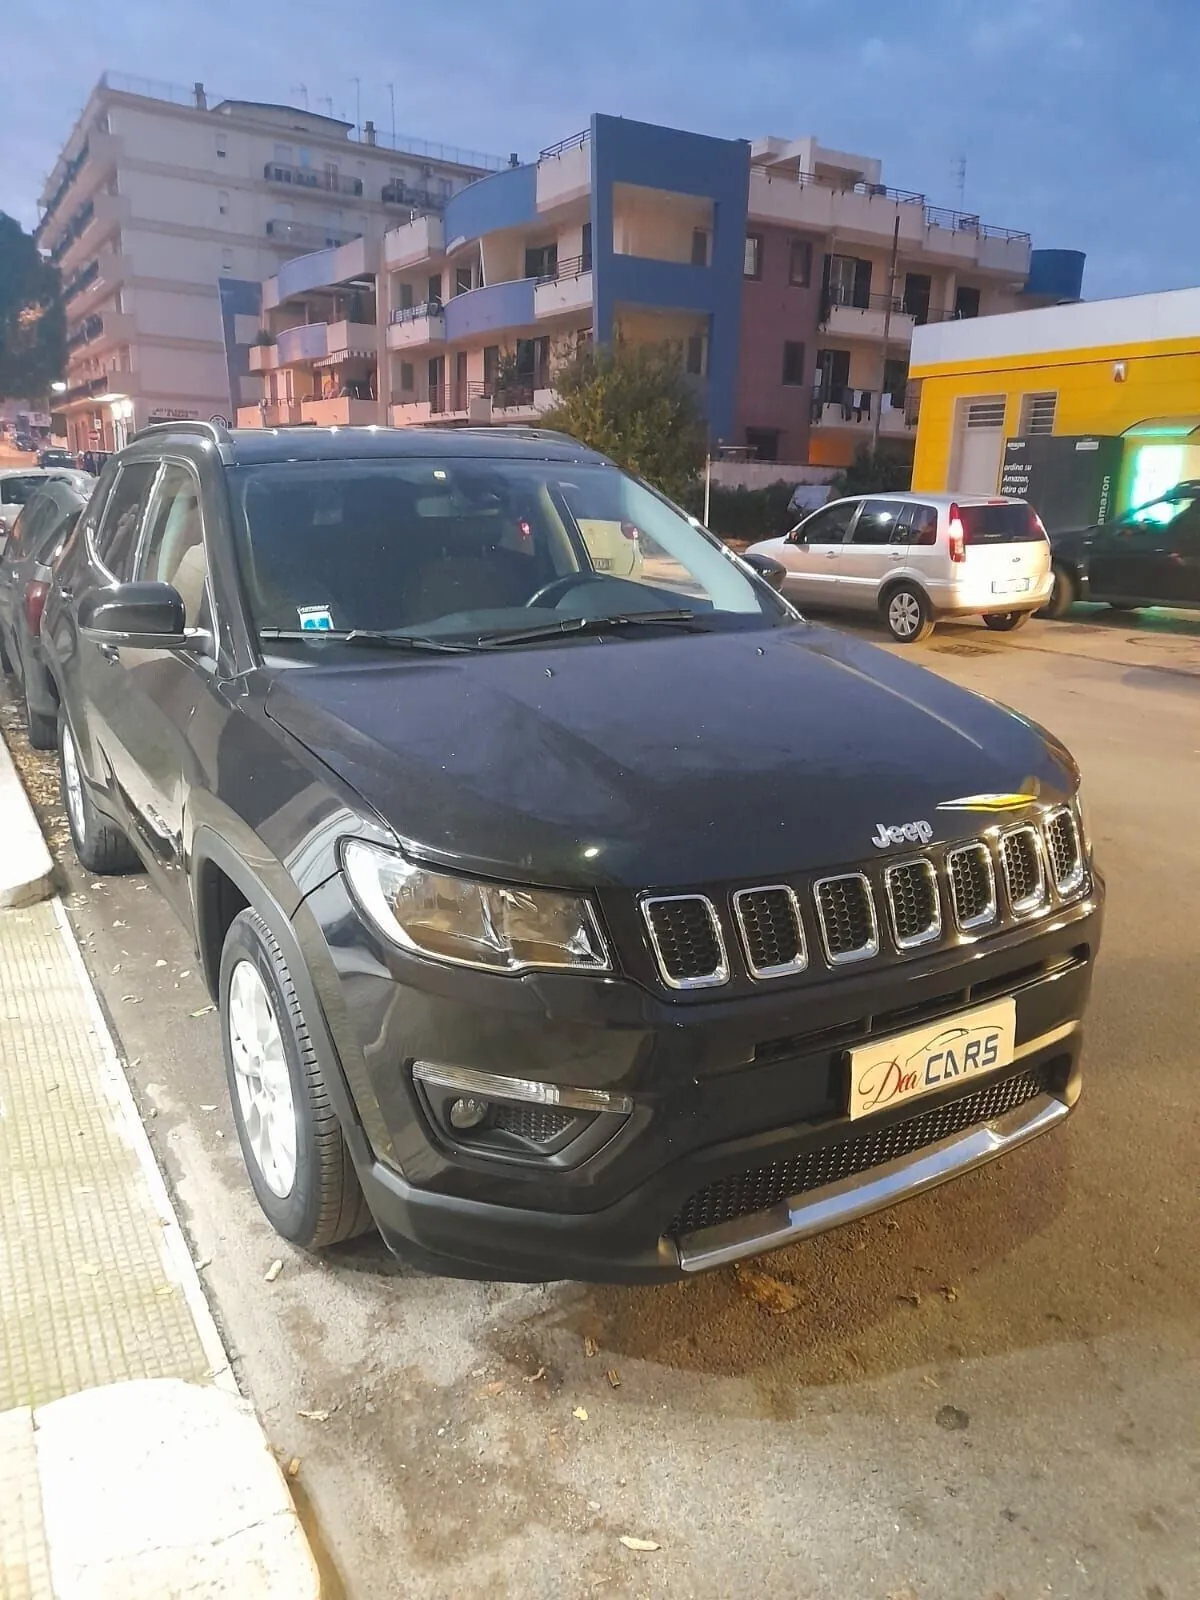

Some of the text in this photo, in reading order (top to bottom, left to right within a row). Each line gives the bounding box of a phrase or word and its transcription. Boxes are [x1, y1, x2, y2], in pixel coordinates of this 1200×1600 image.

[1097, 475, 1110, 525] amazon
[872, 820, 933, 849] Jeep
[924, 1033, 999, 1085] CARS
